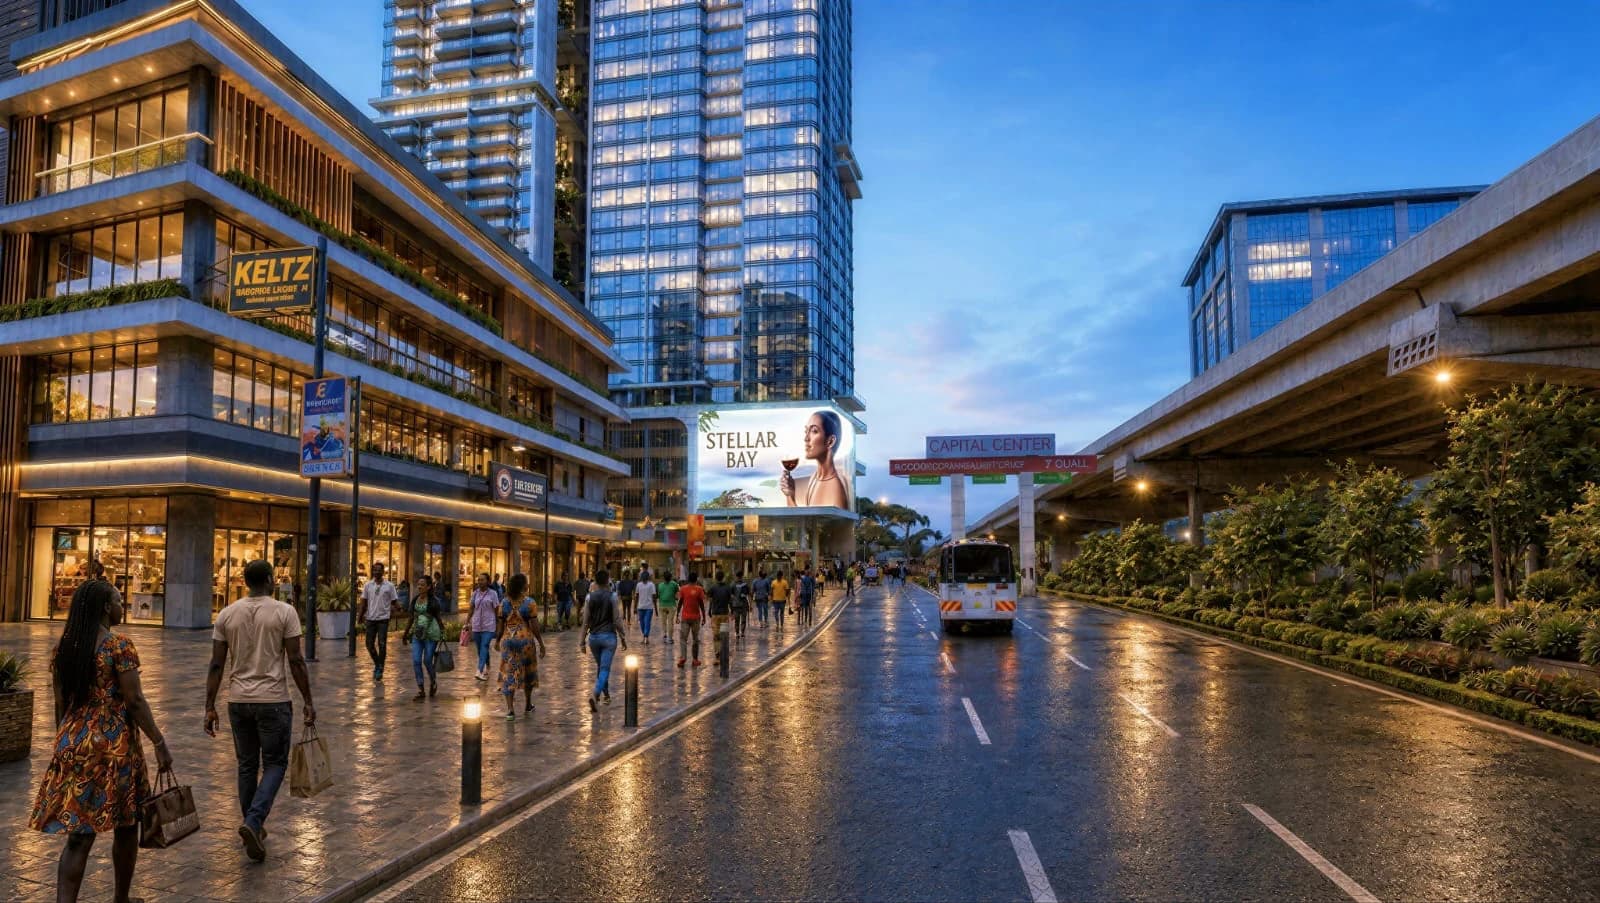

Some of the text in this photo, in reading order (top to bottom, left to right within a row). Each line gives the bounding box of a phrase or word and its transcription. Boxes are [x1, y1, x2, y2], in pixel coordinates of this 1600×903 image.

[233, 255, 313, 286] KELTZ
[706, 431, 778, 449] STELLAR
[929, 437, 1051, 453] CAPITAL CENTER
[726, 451, 758, 468] BAY
